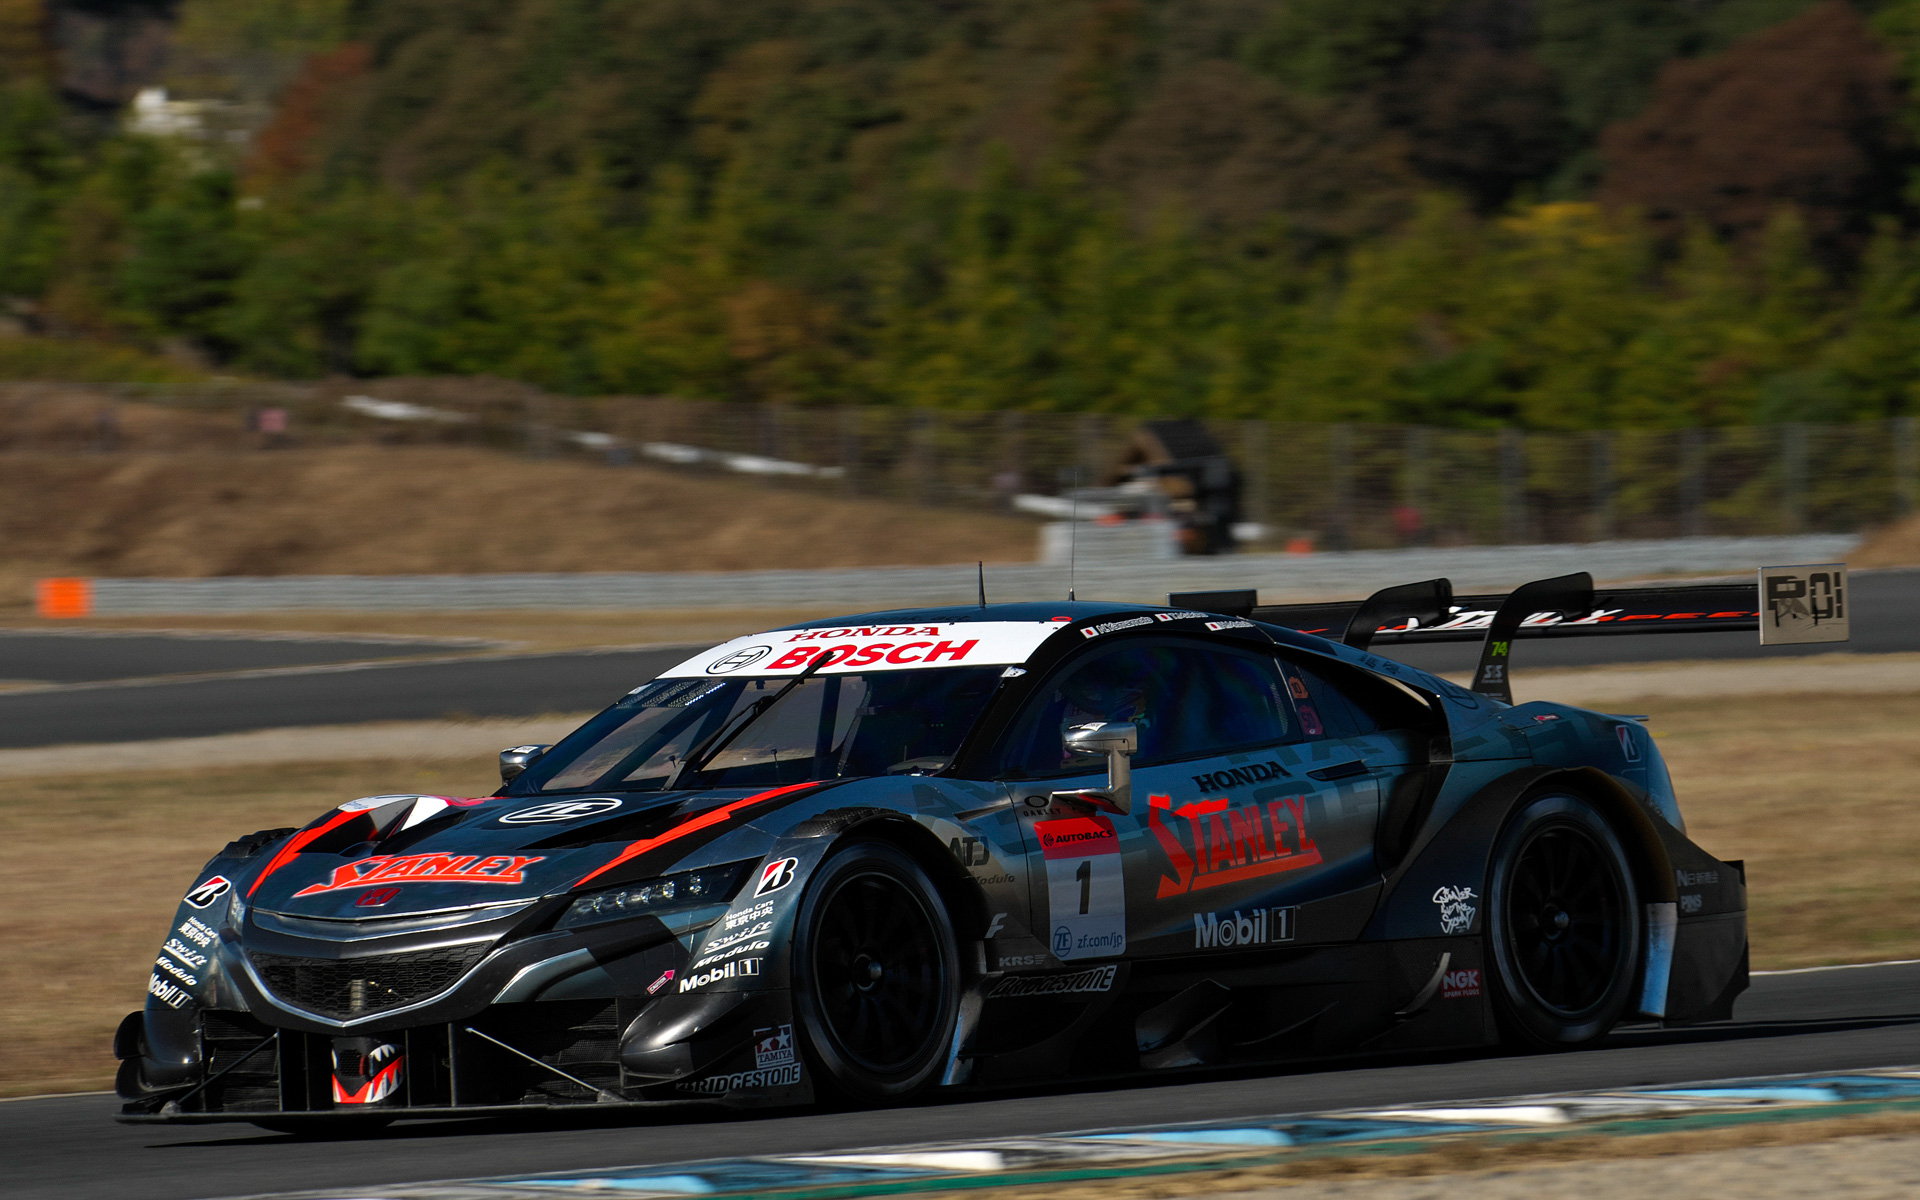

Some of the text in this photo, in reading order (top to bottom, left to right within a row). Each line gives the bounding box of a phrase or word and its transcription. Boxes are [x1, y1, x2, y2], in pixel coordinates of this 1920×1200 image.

[783, 626, 941, 644] HONDA
[764, 639, 981, 670] BOSCH
[1191, 760, 1292, 792] HONDA
[1023, 808, 1062, 817] OAKLEY
[1055, 830, 1113, 844] AUTOBACS
[1148, 794, 1324, 900] STANLEY
[291, 852, 548, 898] STANLEY
[1075, 860, 1091, 915] 1
[725, 900, 774, 921] Honda Cars
[725, 906, 774, 930] 東京中央
[706, 921, 773, 949] Swift
[1077, 931, 1123, 949] zf.com/jp
[1193, 908, 1267, 948] Mobil
[166, 938, 208, 966] Swift
[693, 940, 770, 970] Modulo
[155, 956, 198, 986] Modulo
[679, 961, 736, 993] Mobil
[988, 965, 1117, 998] BRIDGESTONE
[1443, 970, 1479, 989] NGK
[758, 1049, 793, 1063] TAMIYA
[676, 1063, 801, 1094] BRIDGESTONE
